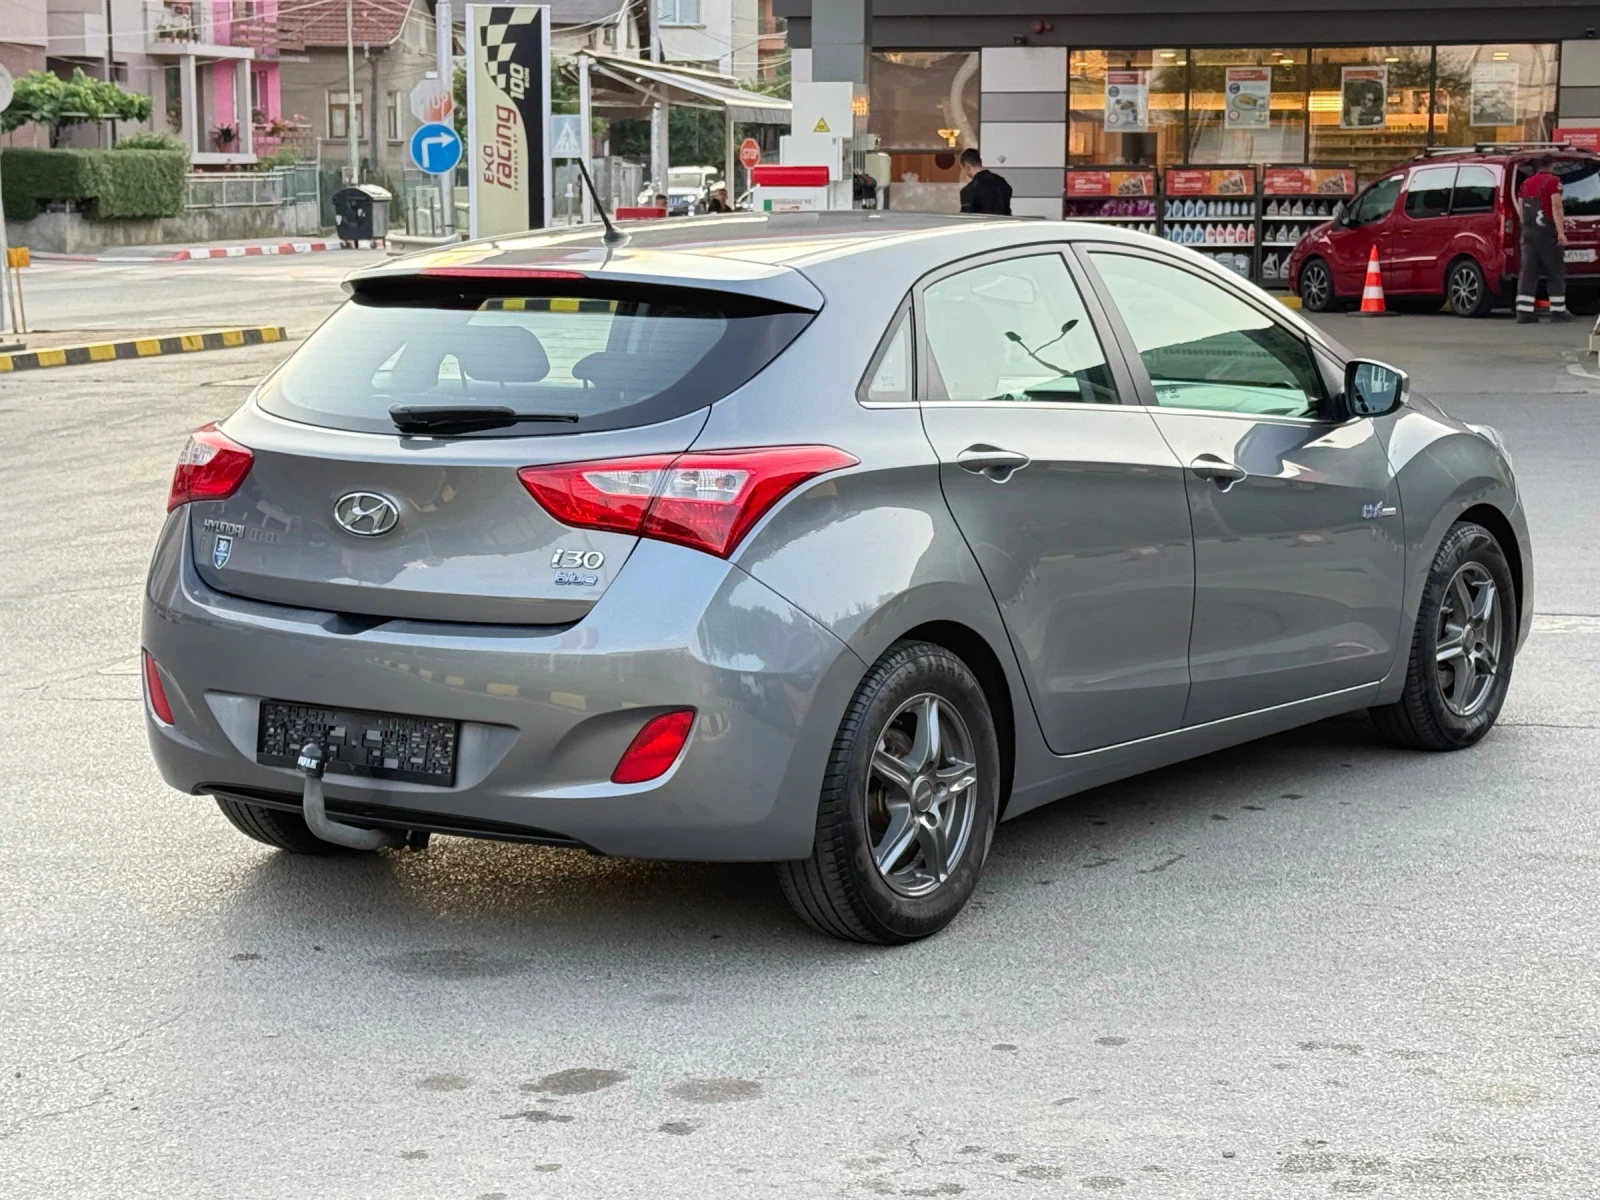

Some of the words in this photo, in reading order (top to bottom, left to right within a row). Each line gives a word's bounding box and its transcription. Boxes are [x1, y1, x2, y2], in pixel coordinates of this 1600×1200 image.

[509, 62, 525, 100] 100
[496, 104, 517, 190] racing
[204, 518, 245, 538] HYUNDAI
[551, 548, 605, 570] i30
